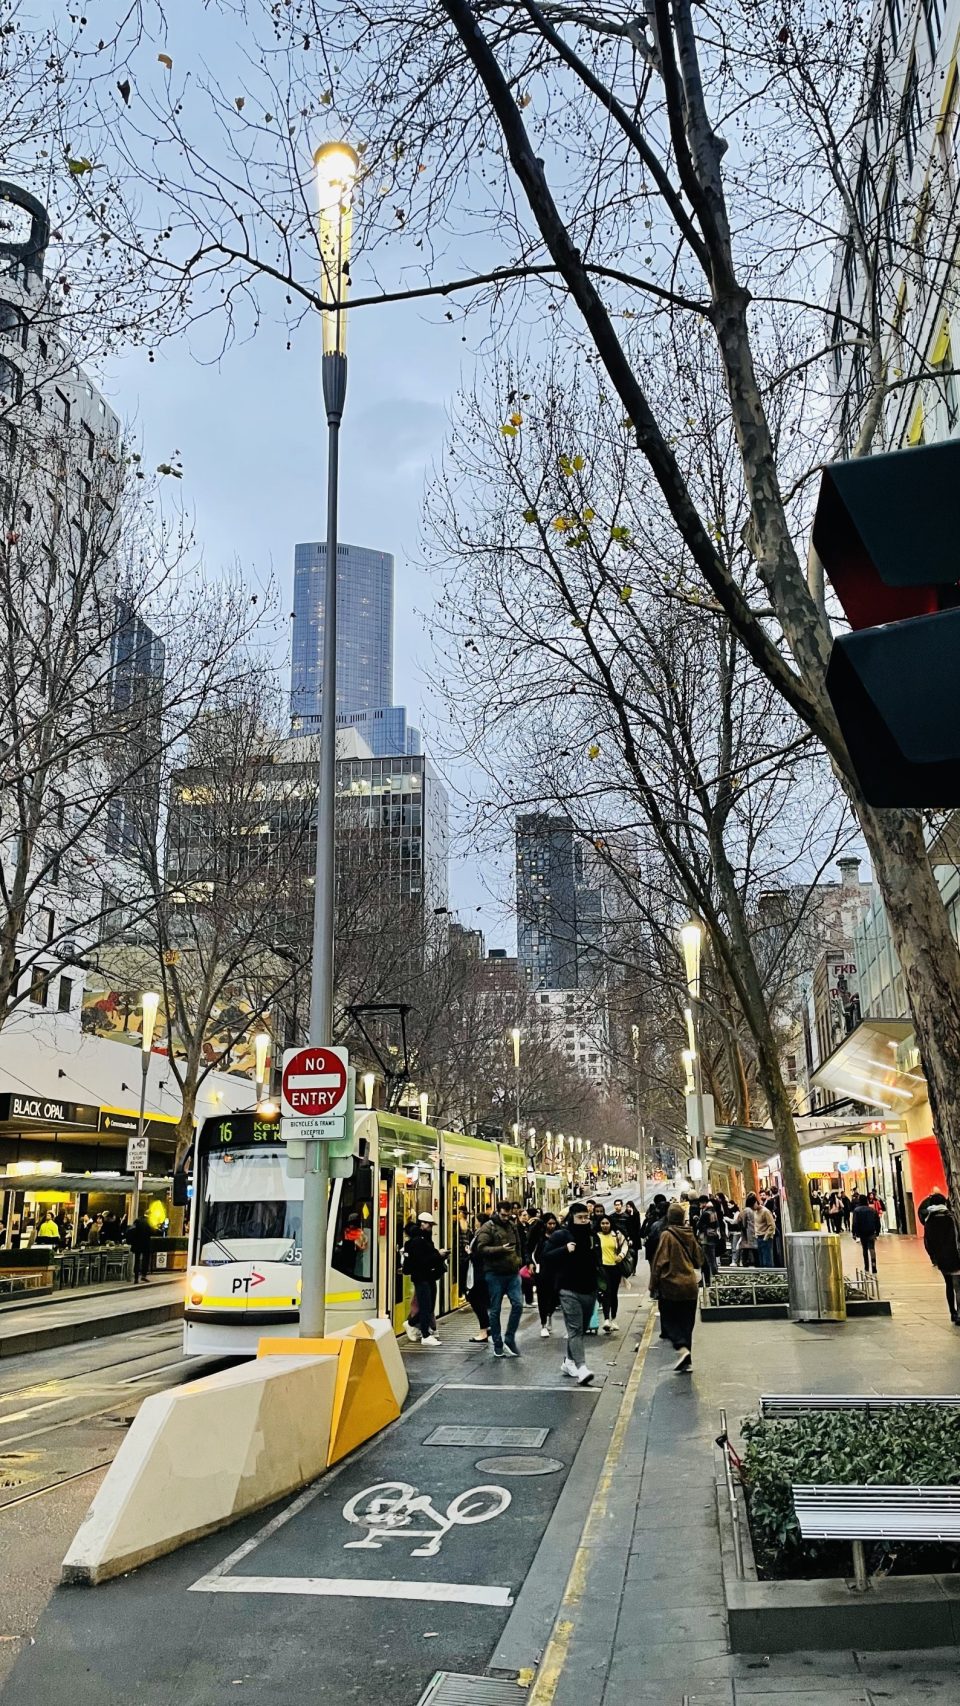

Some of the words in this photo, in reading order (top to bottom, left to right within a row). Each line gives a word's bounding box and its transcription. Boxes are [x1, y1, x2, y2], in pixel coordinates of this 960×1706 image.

[305, 1057, 326, 1071] NO
[291, 1091, 336, 1106] ENTRY
[13, 1098, 41, 1117] BLACK
[44, 1104, 65, 1120] OPAL
[219, 1122, 233, 1143] 16
[253, 1121, 280, 1131] Kew
[253, 1132, 268, 1141] St
[273, 1132, 281, 1141] K
[286, 1248, 302, 1262] 35
[361, 1288, 375, 1300] 3521
